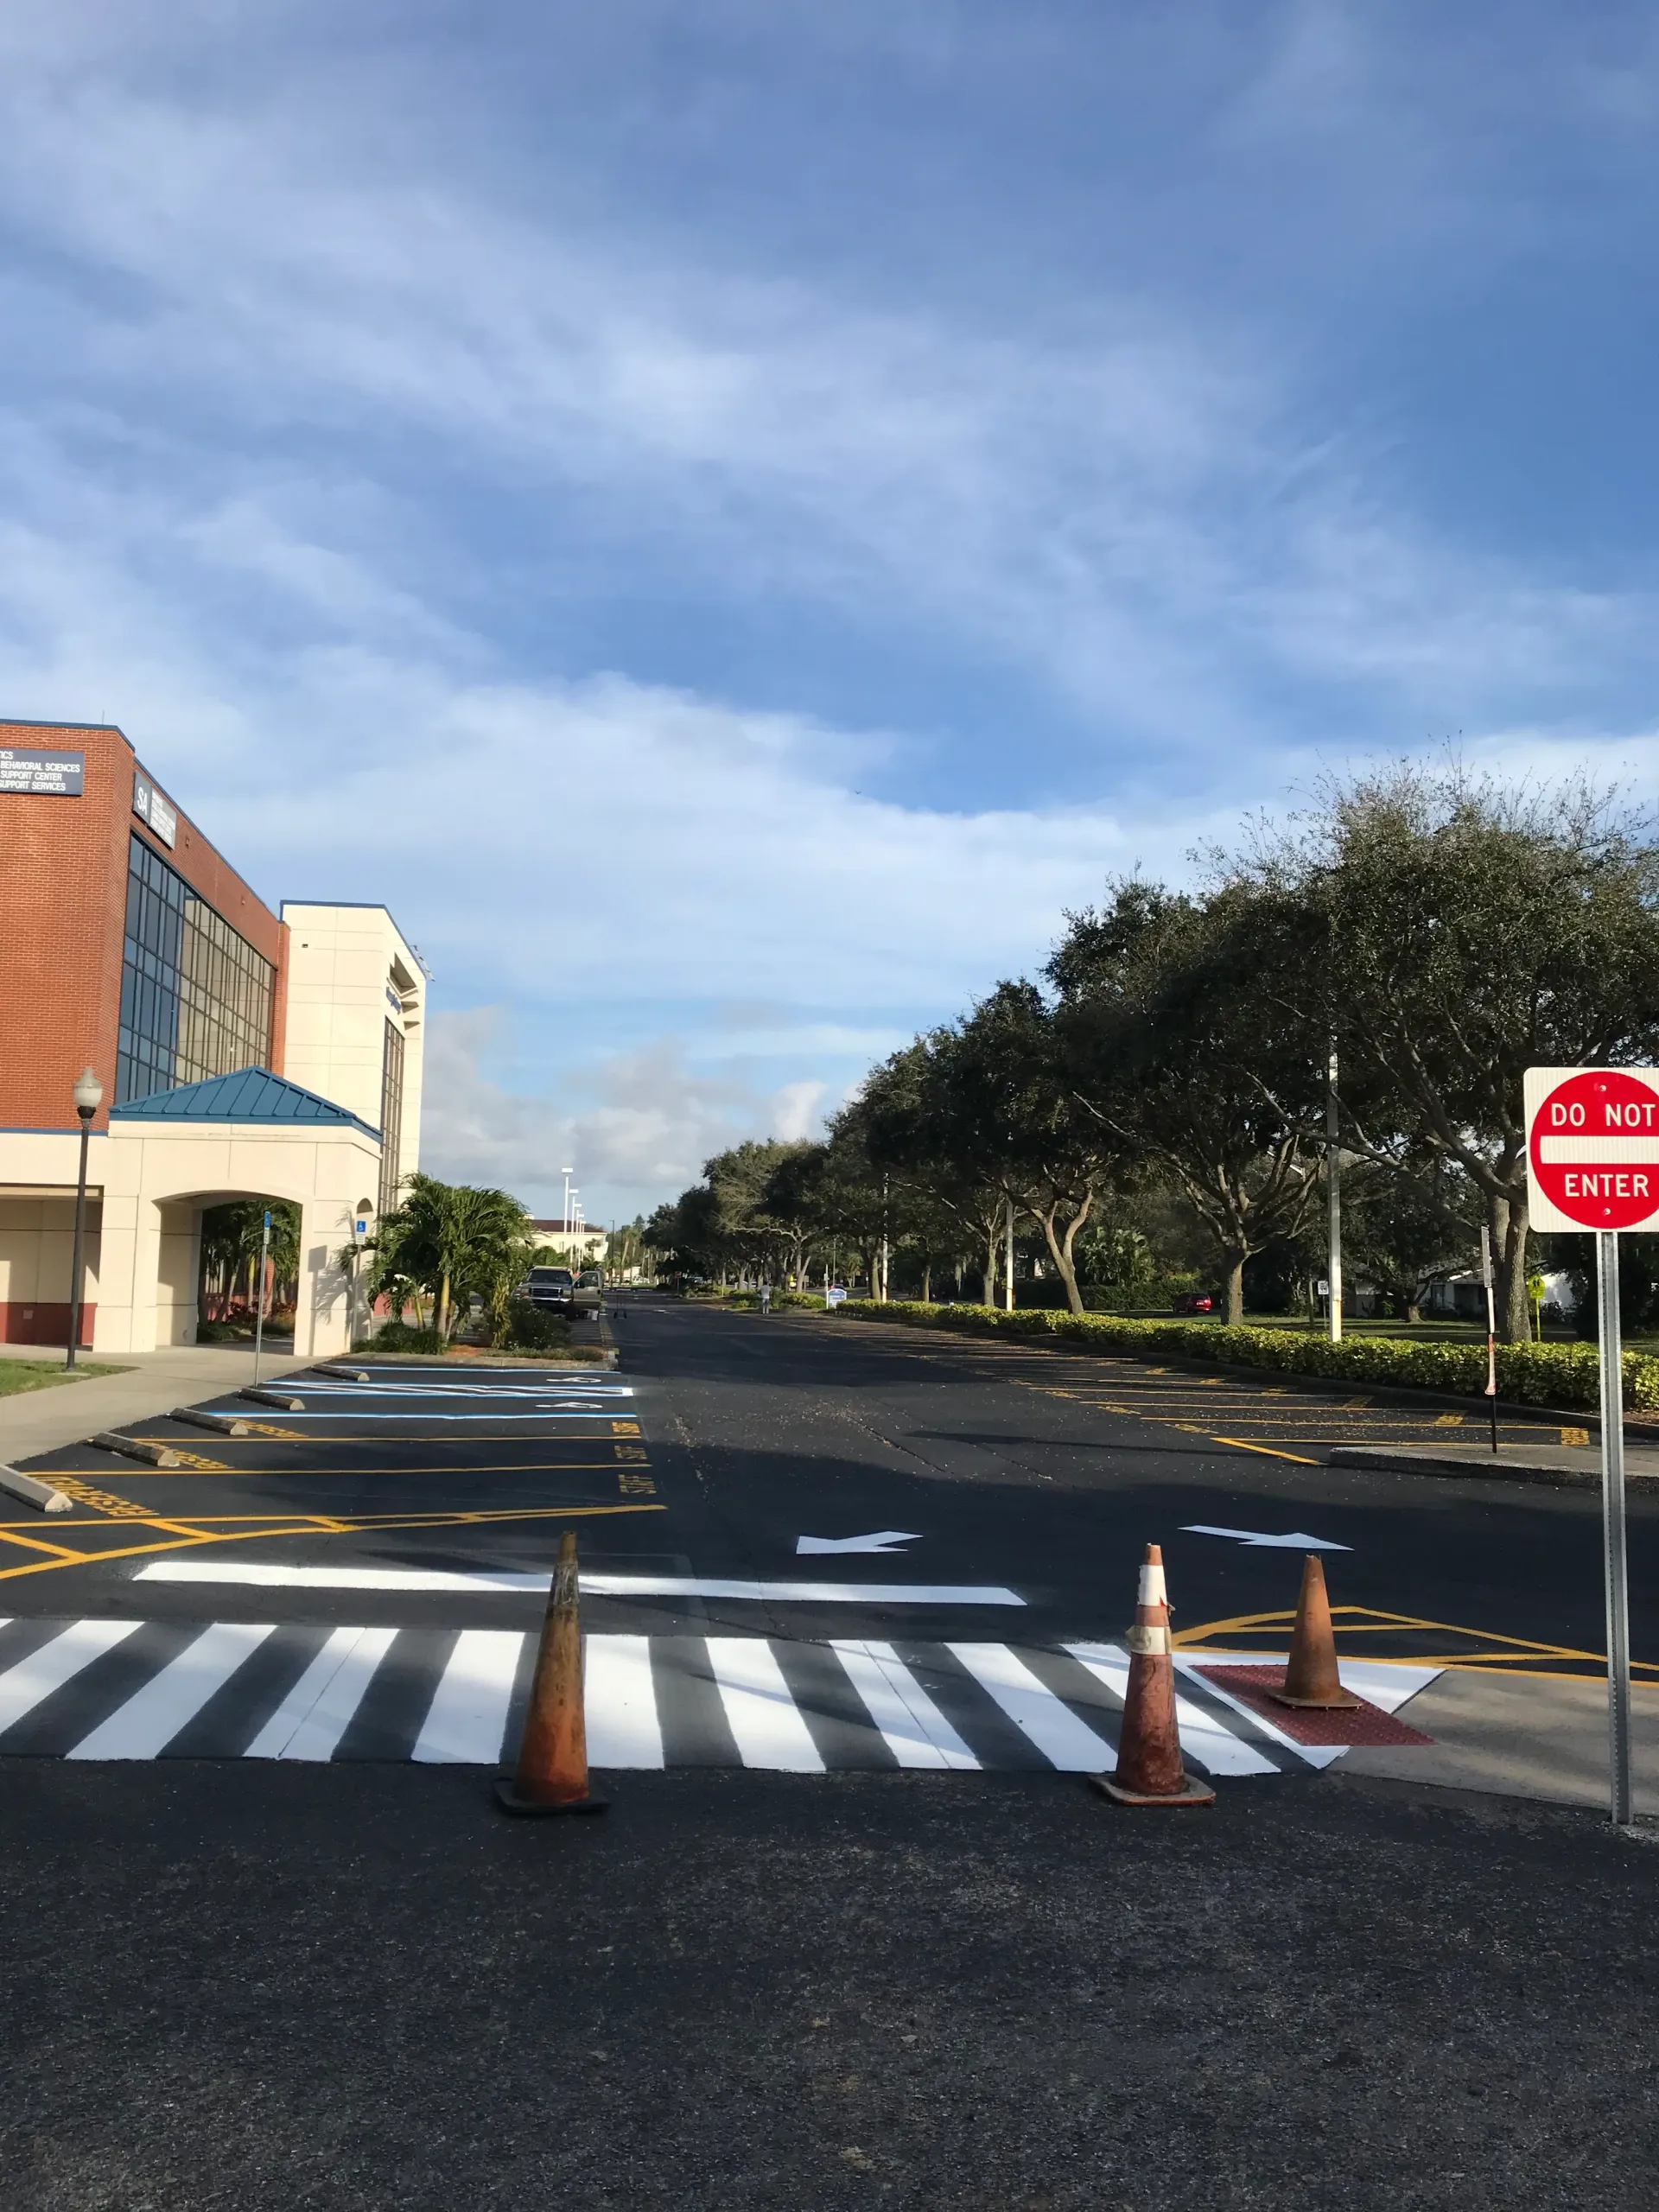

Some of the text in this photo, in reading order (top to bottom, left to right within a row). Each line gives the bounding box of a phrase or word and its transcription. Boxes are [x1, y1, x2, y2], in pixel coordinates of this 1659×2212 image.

[1, 760, 80, 772] BEHAVIORAL SCIENCES
[1, 770, 62, 781] SUPPORT CENTER
[0, 779, 67, 791] SUPPORT SERVICES
[137, 786, 148, 816] SA
[1551, 1103, 1656, 1127] DO NOT
[1565, 1173, 1649, 1198] ENTER
